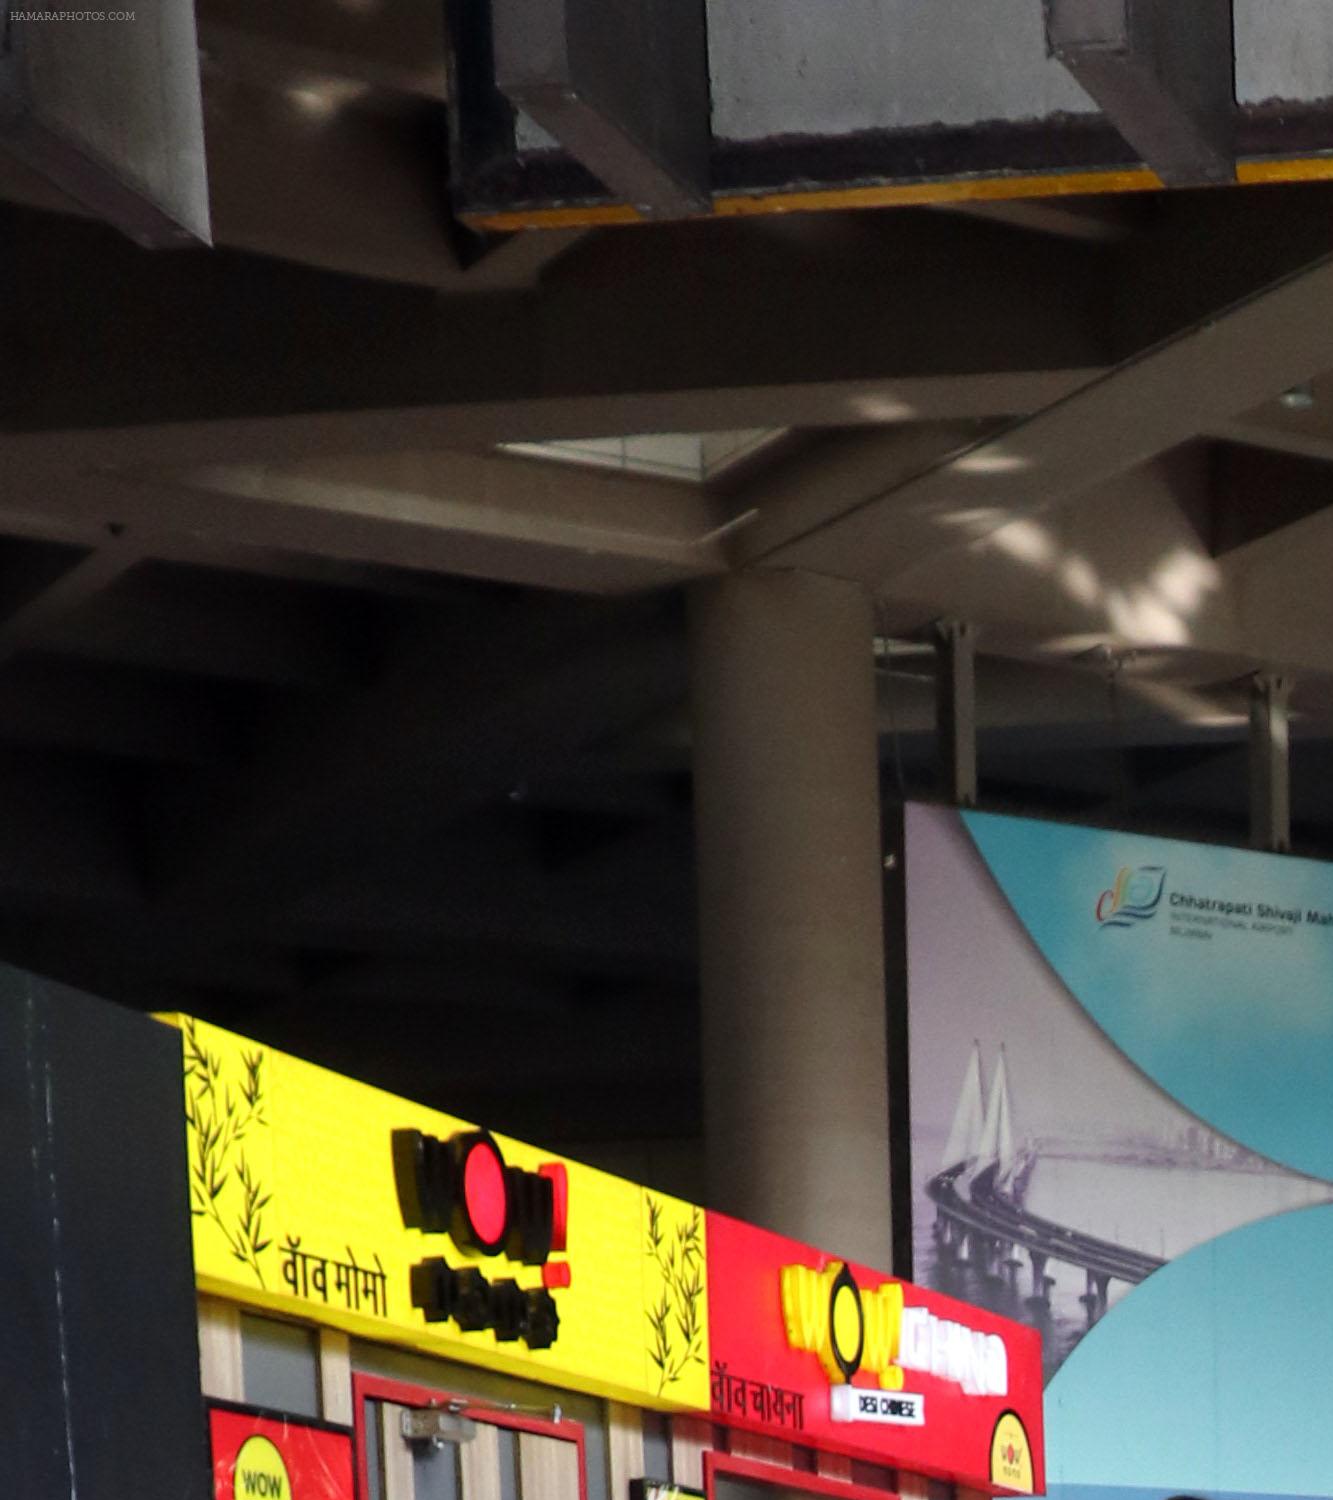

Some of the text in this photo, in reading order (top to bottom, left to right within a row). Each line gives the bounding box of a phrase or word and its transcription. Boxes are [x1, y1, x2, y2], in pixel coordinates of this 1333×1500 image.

[1257, 902, 1302, 923] Shivaji
[332, 1246, 387, 1317] मोमो
[243, 1469, 282, 1499] WOW
